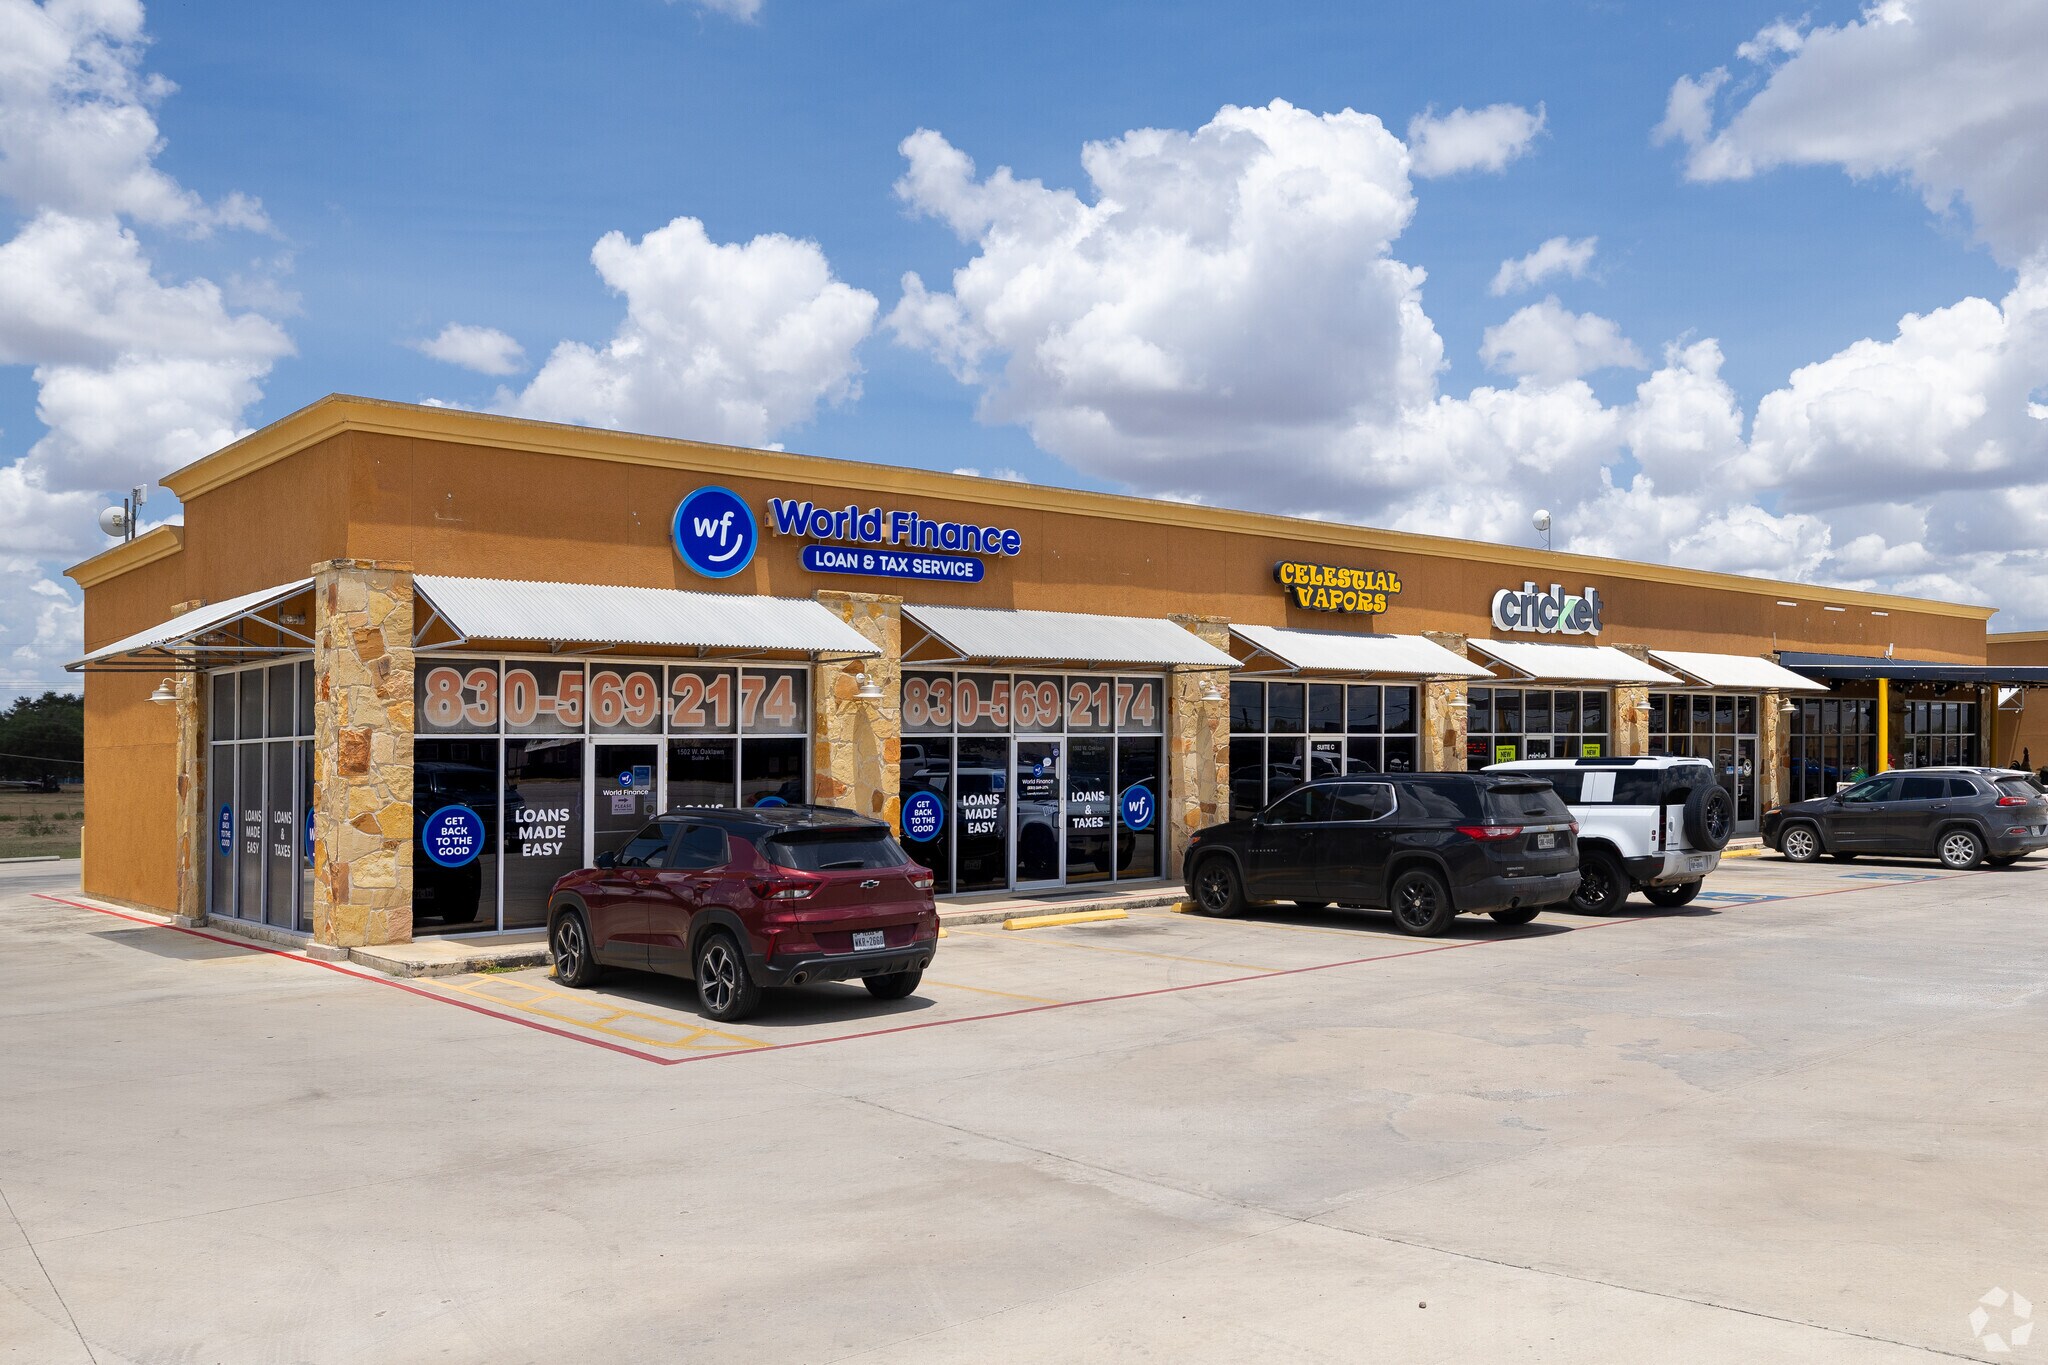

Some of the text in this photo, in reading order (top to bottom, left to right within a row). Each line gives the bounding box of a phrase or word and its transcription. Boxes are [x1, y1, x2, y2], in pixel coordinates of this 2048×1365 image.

[693, 511, 735, 546] wf
[768, 498, 1022, 556] World Finance
[815, 551, 974, 578] LOAN & TAX SERVICE
[1280, 562, 1402, 593] CELESTIAL
[1298, 586, 1387, 613] VAPORS
[1497, 583, 1603, 633] cricket
[424, 667, 797, 727] 830-569-2174
[963, 794, 1000, 806] LOANS
[1071, 791, 1105, 802] LOANS
[916, 800, 930, 808] GET
[1084, 805, 1092, 815] &
[1128, 797, 1146, 815] wf
[245, 810, 261, 822] LOANS
[274, 811, 292, 824] LOANS
[515, 808, 570, 823] LOANS
[914, 808, 932, 816] BACK
[965, 808, 997, 820] MADE
[445, 816, 464, 825] GET
[911, 816, 935, 825] TO THE
[1072, 817, 1103, 829] TAXES
[246, 826, 260, 838] MADE
[280, 828, 285, 840] &
[441, 827, 468, 836] BACK
[519, 825, 566, 841] MADE
[912, 824, 934, 833] GOOD
[967, 822, 996, 834] EASY
[436, 836, 473, 846] TO THE
[247, 842, 259, 854] EASY
[274, 844, 291, 857] TAXES
[438, 846, 470, 856] GOOD
[522, 842, 563, 857] EASY
